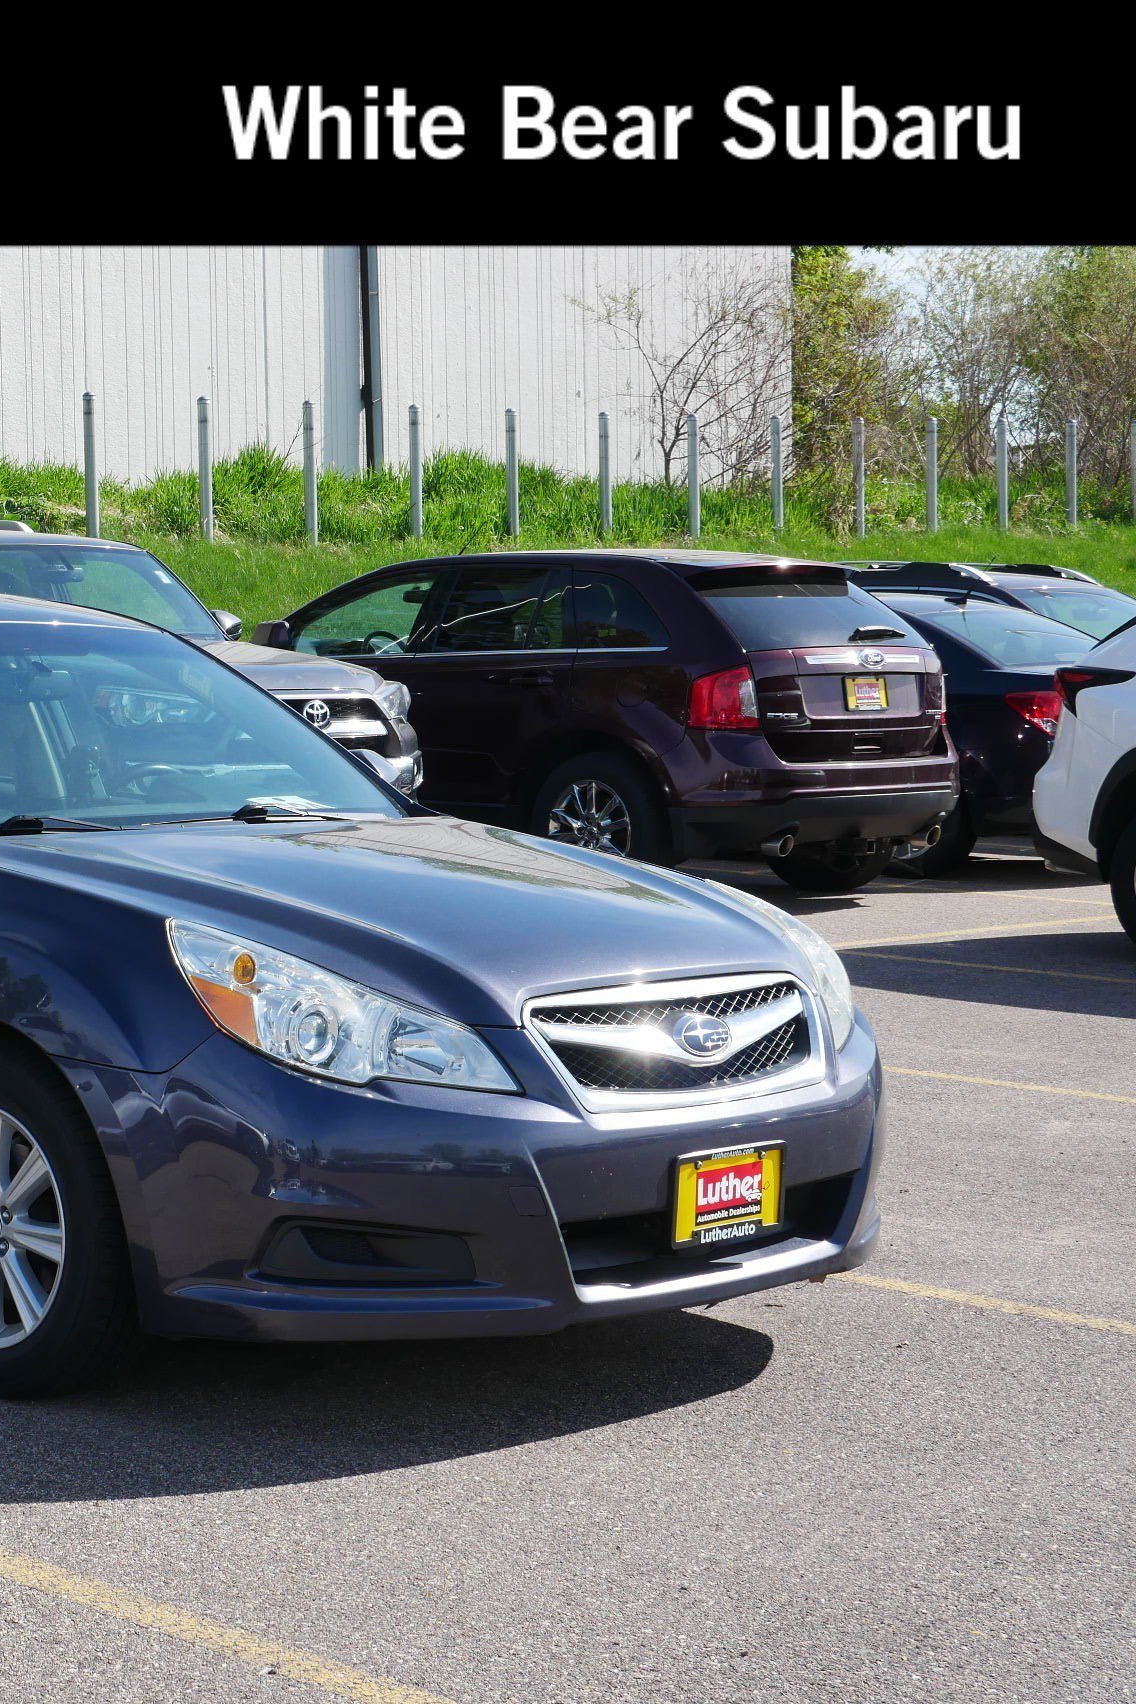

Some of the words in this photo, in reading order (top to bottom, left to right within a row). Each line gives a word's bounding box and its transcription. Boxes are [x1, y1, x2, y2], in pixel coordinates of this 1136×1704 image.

[697, 1172, 762, 1206] Luther
[696, 1208, 729, 1224] Automobile
[729, 1203, 761, 1217] Dealerships
[700, 1222, 756, 1244] LutherAuto
